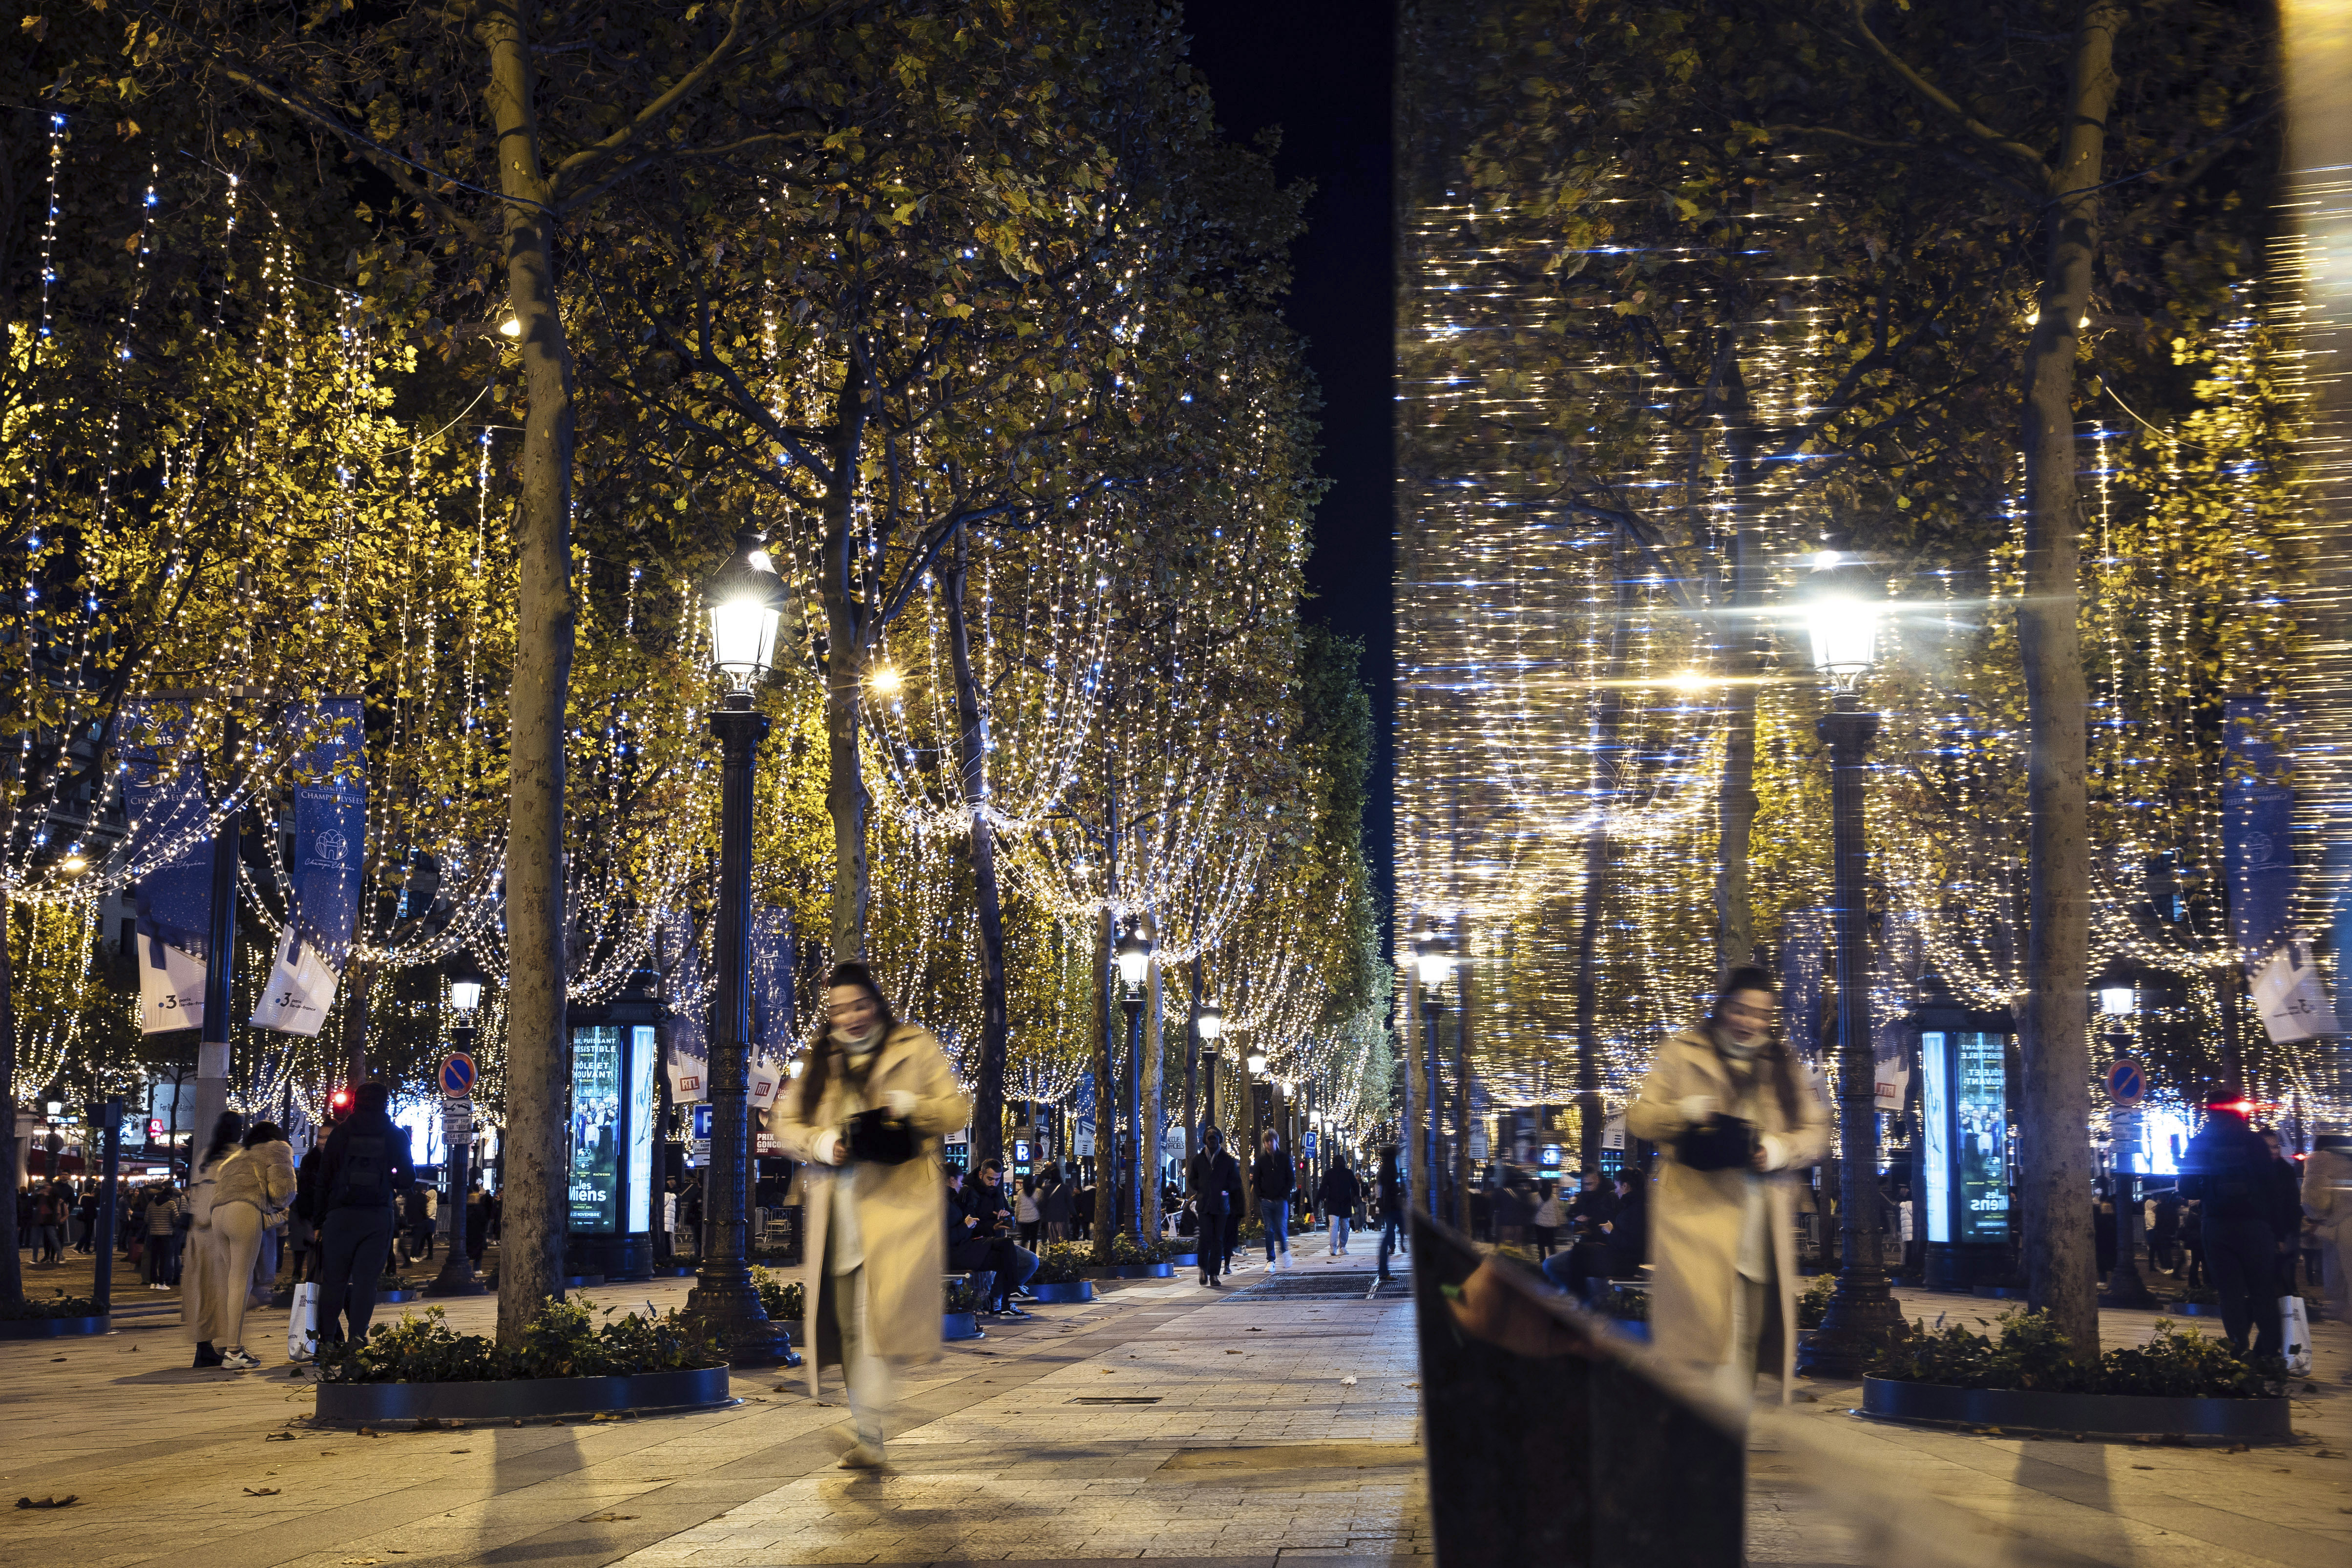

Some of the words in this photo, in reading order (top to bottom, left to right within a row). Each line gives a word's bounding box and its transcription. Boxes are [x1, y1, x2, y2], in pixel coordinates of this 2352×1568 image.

[140, 736, 174, 745] RIS
[166, 995, 177, 1009] 3
[280, 992, 293, 1007] 3
[289, 1003, 316, 1011] île-de-france
[683, 1079, 698, 1090] RTL
[756, 1083, 769, 1095] RTL
[151, 1121, 161, 1130] Q
[1308, 1135, 1314, 1145] P
[1017, 1145, 1028, 1160] P
[579, 1179, 591, 1190] les
[568, 1185, 607, 1202] Miens
